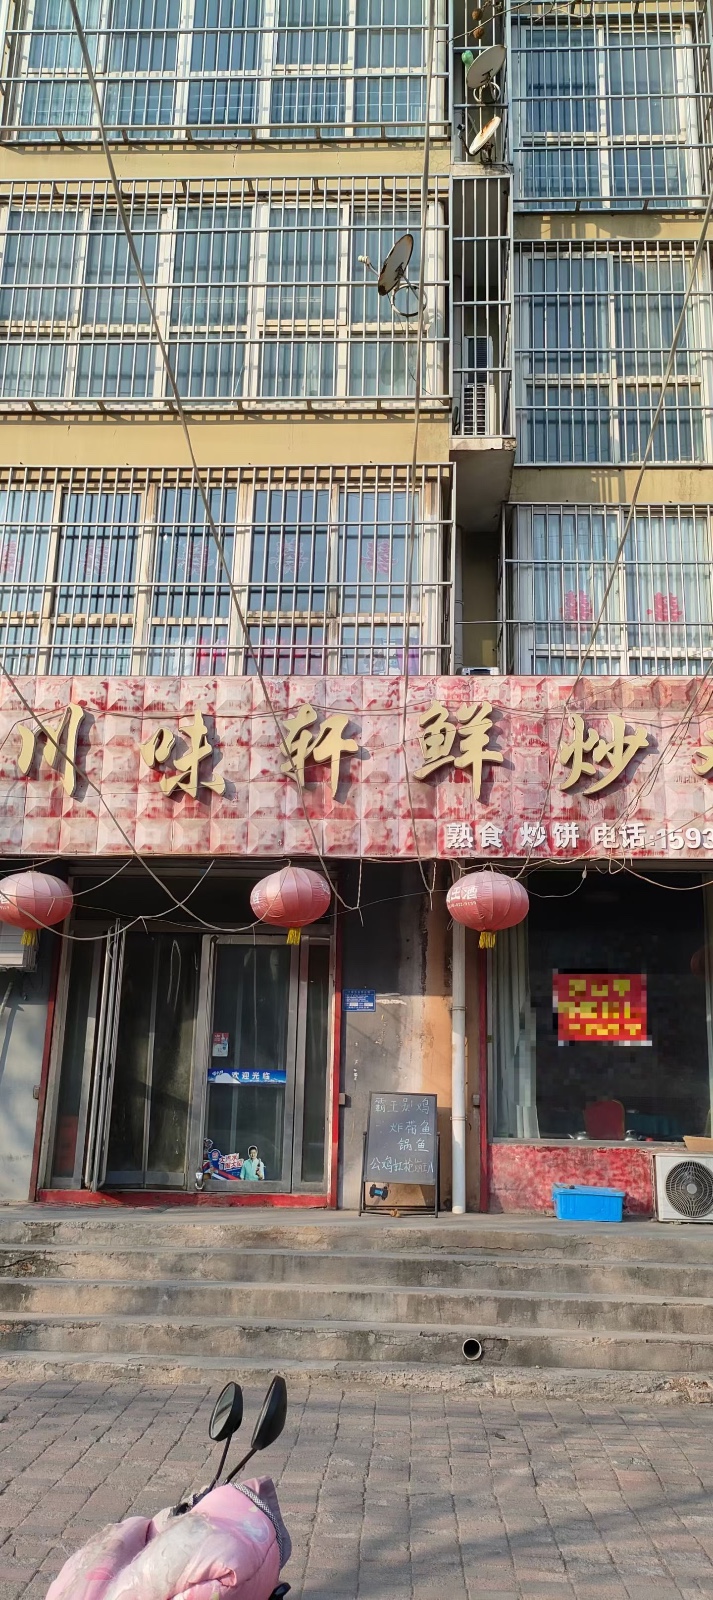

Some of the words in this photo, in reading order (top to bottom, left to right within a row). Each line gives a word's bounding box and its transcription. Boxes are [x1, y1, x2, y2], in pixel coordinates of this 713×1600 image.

[447, 822, 504, 849] 熟食
[520, 822, 579, 849] 炒饼
[231, 1071, 271, 1080] 欢迎光临
[374, 1097, 429, 1115] 霸王别鸡
[389, 1119, 432, 1136] 炸带鱼
